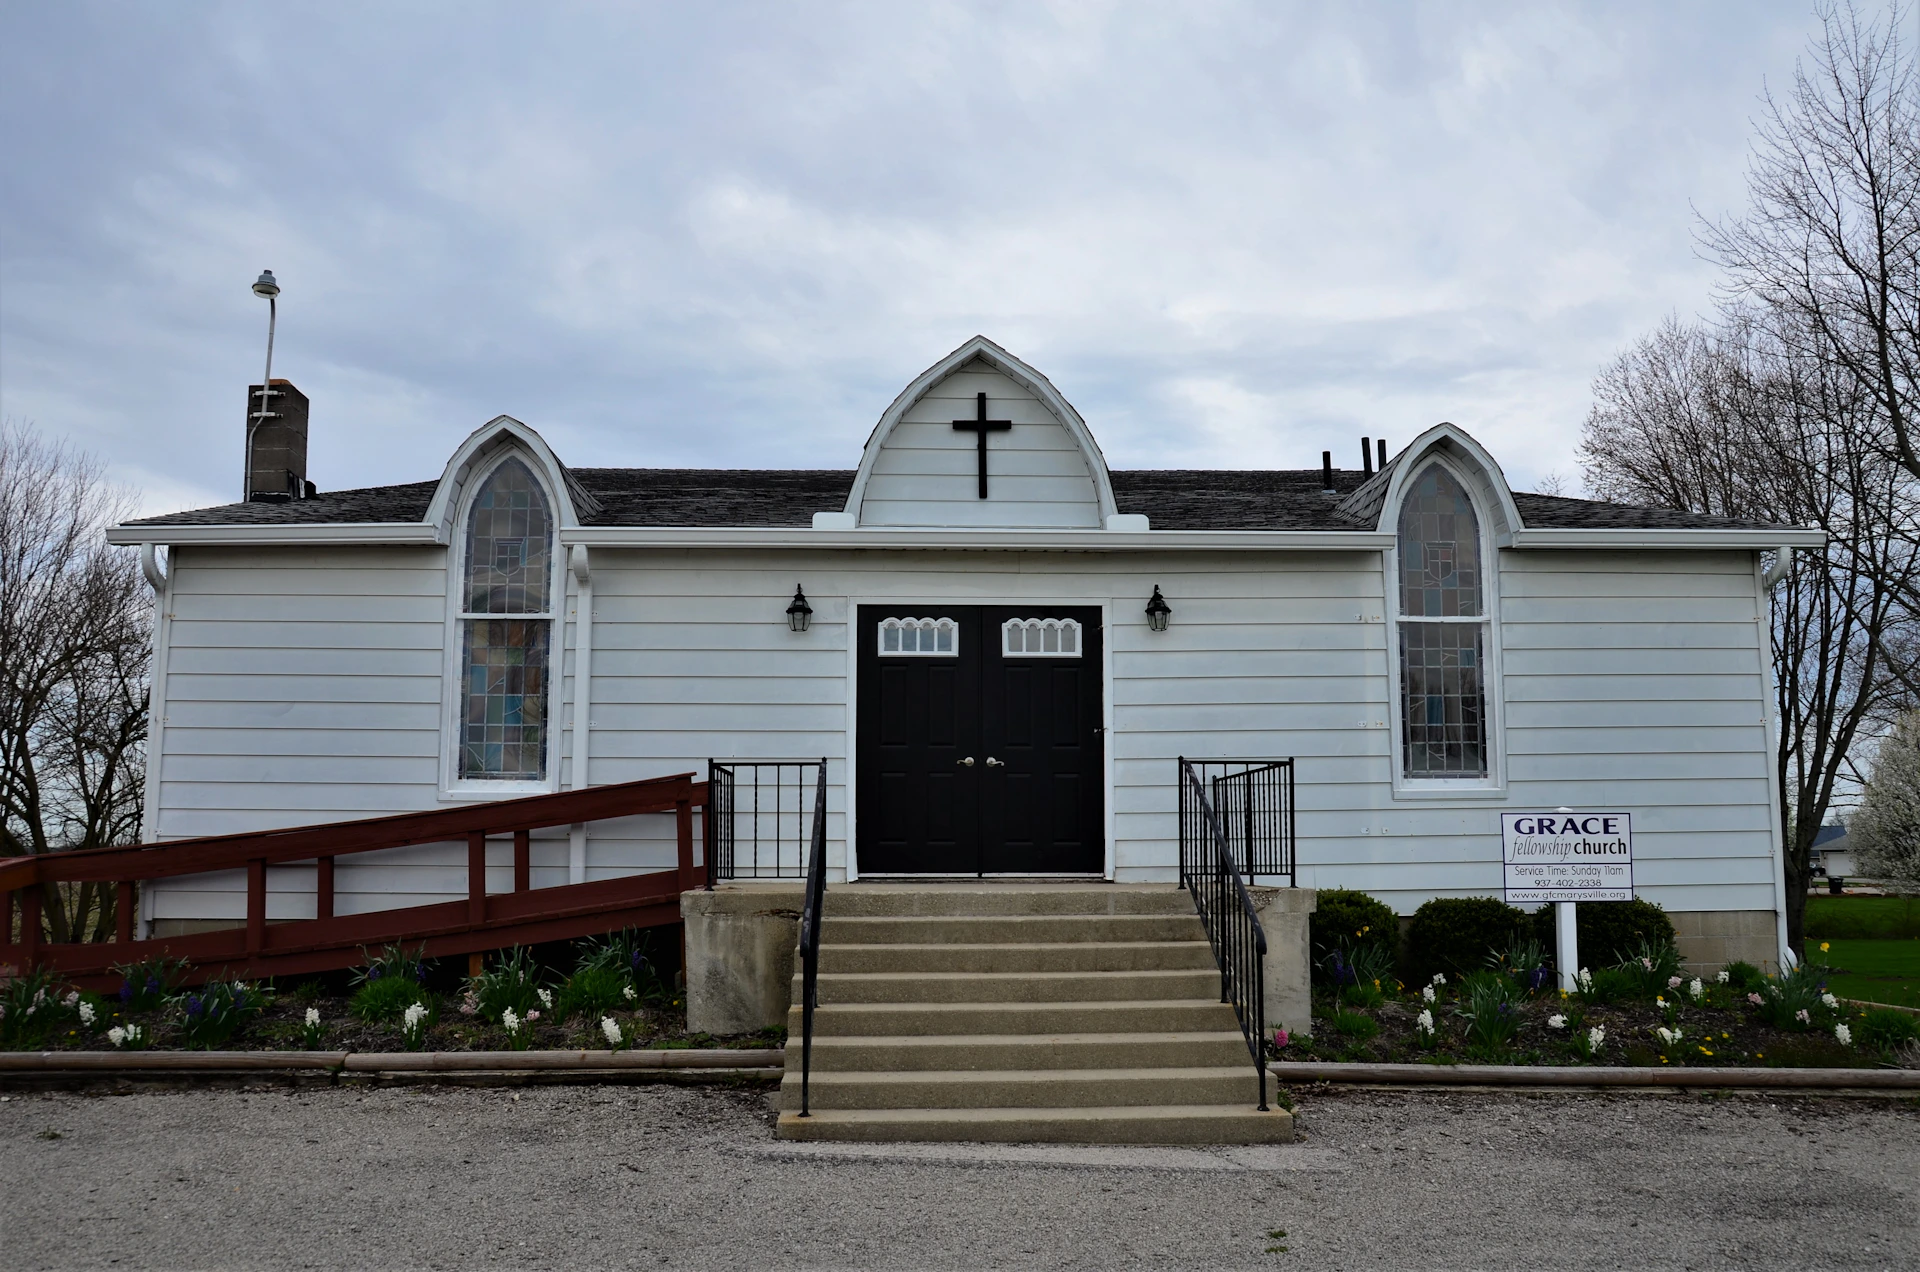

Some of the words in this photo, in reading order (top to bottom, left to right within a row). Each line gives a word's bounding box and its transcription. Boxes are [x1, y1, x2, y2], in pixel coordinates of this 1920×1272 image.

[1514, 817, 1620, 835] GRACE
[1509, 836, 1572, 862] fellowship
[1574, 838, 1627, 855] church
[1514, 865, 1544, 876] Service
[1546, 865, 1569, 876] Time:
[1571, 865, 1602, 878] Sunday
[1604, 865, 1624, 876] 11am
[1534, 879, 1602, 887] 937-402-2338
[1510, 890, 1626, 900] www.gfcmarysville.org
